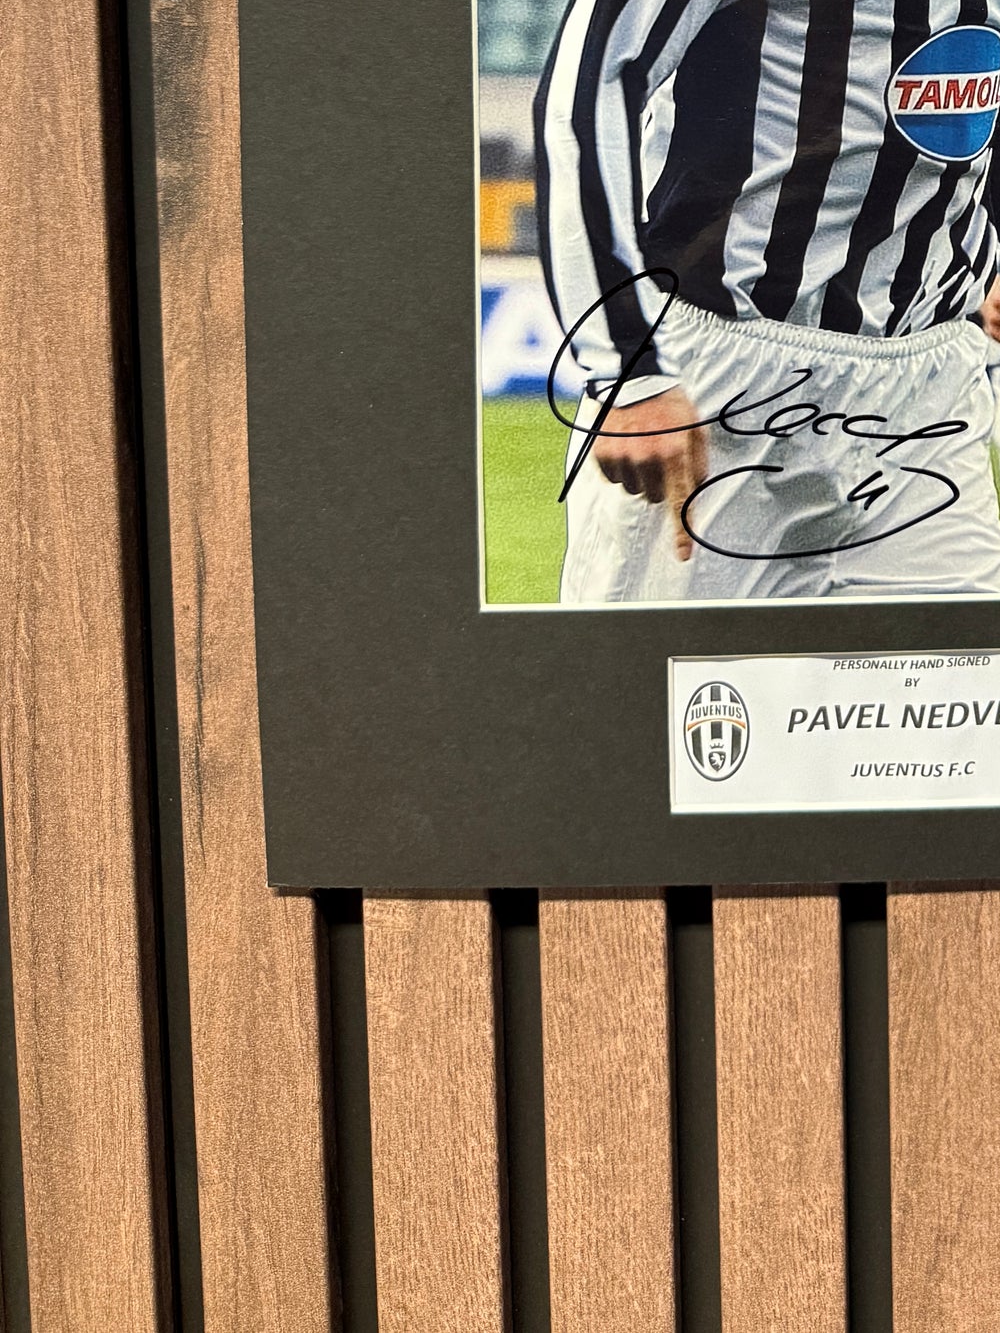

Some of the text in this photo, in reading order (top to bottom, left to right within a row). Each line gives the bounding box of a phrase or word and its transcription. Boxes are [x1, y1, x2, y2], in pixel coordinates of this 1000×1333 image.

[833, 656, 991, 671] PERSONALLY HAND SIGNED
[904, 677, 921, 688] BY
[691, 704, 743, 721] JUVENTUS
[787, 702, 890, 734] PAVEL
[850, 760, 976, 778] JUVENTUS F.C
